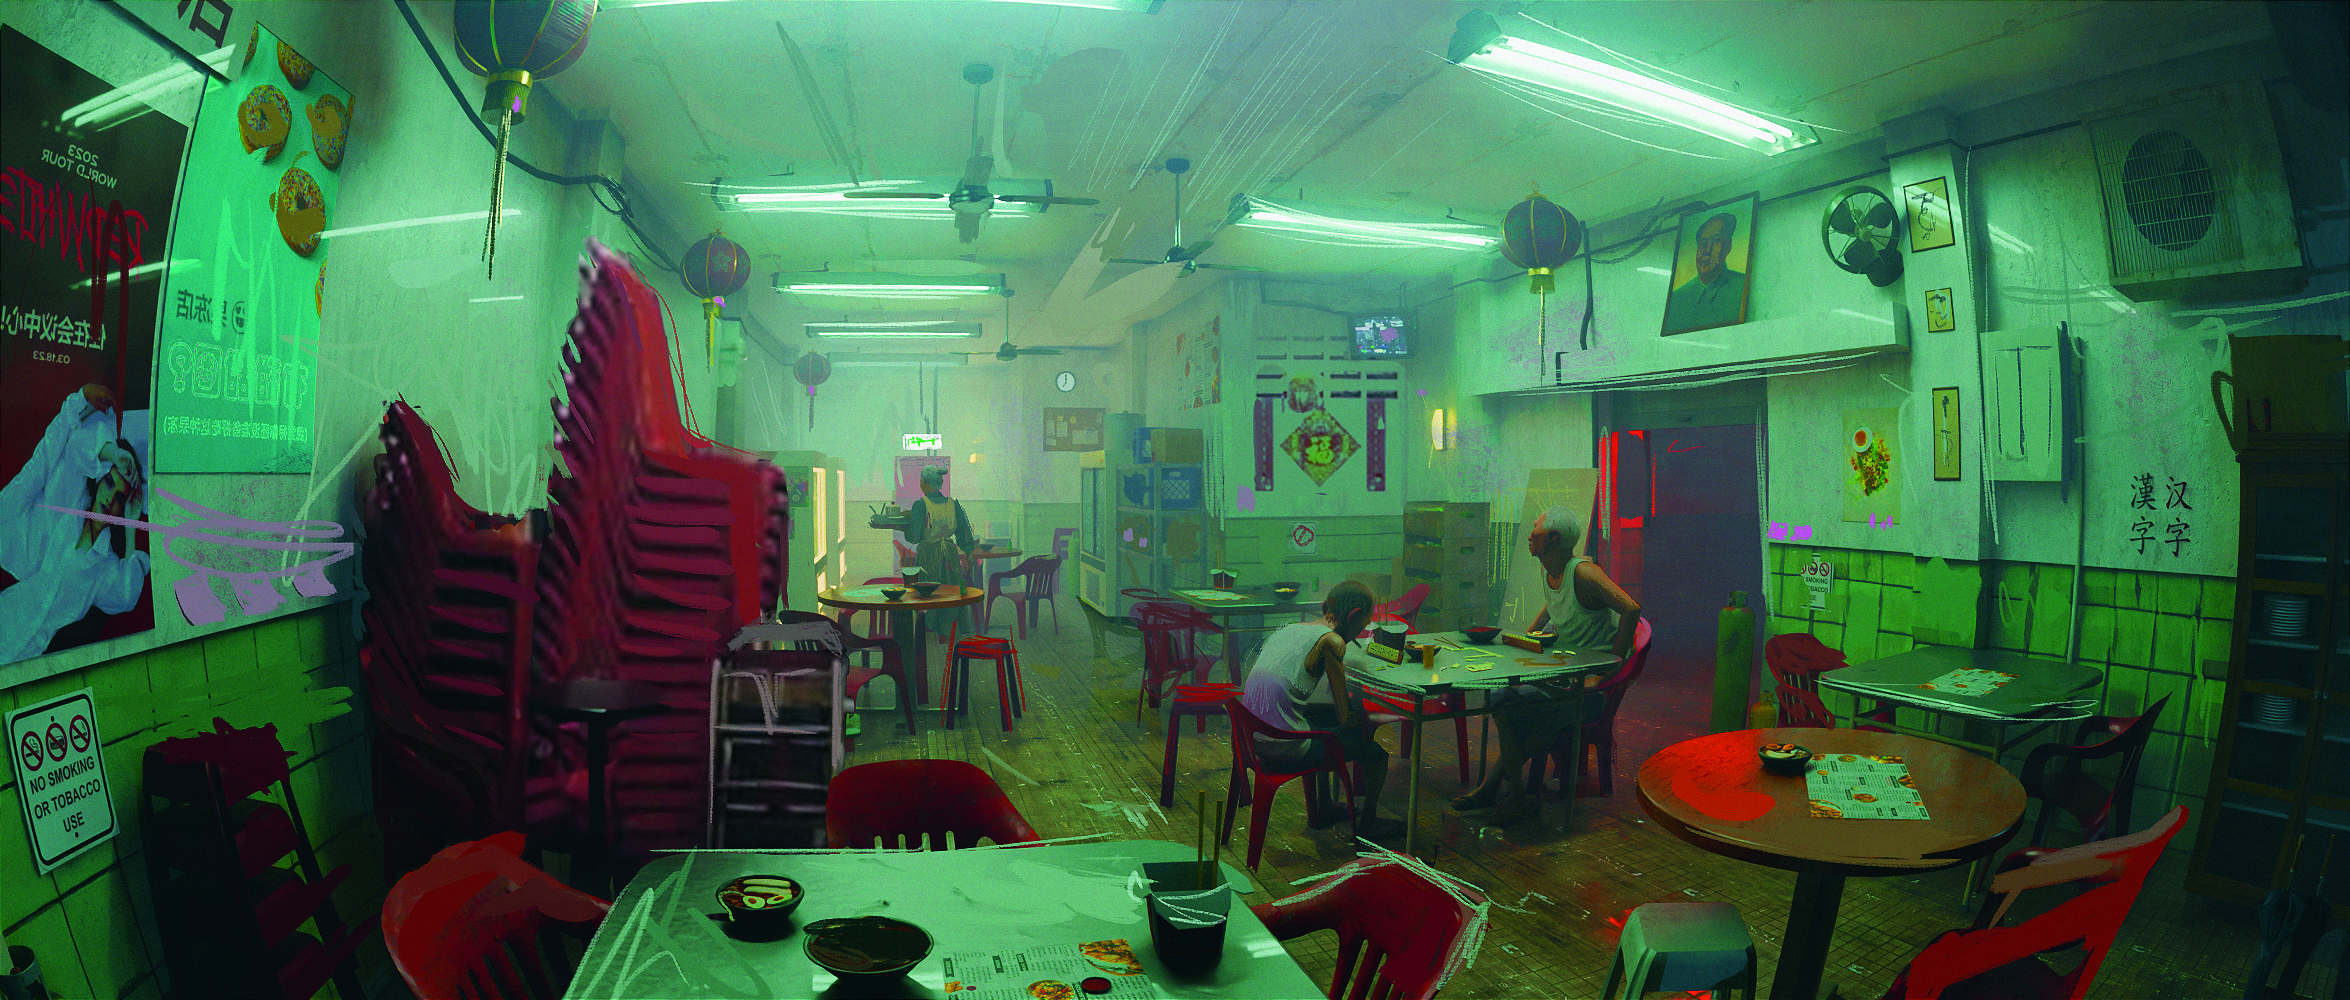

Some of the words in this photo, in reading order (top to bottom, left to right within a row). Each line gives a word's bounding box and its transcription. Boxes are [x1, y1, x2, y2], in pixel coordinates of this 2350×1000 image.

[2130, 473, 2156, 554] 漢字
[2165, 476, 2192, 556] 汉字
[30, 776, 46, 794] NO
[48, 756, 94, 786] SMOKING
[34, 801, 51, 820] OR
[51, 779, 100, 811] TOBACCO
[63, 811, 84, 832] USE
